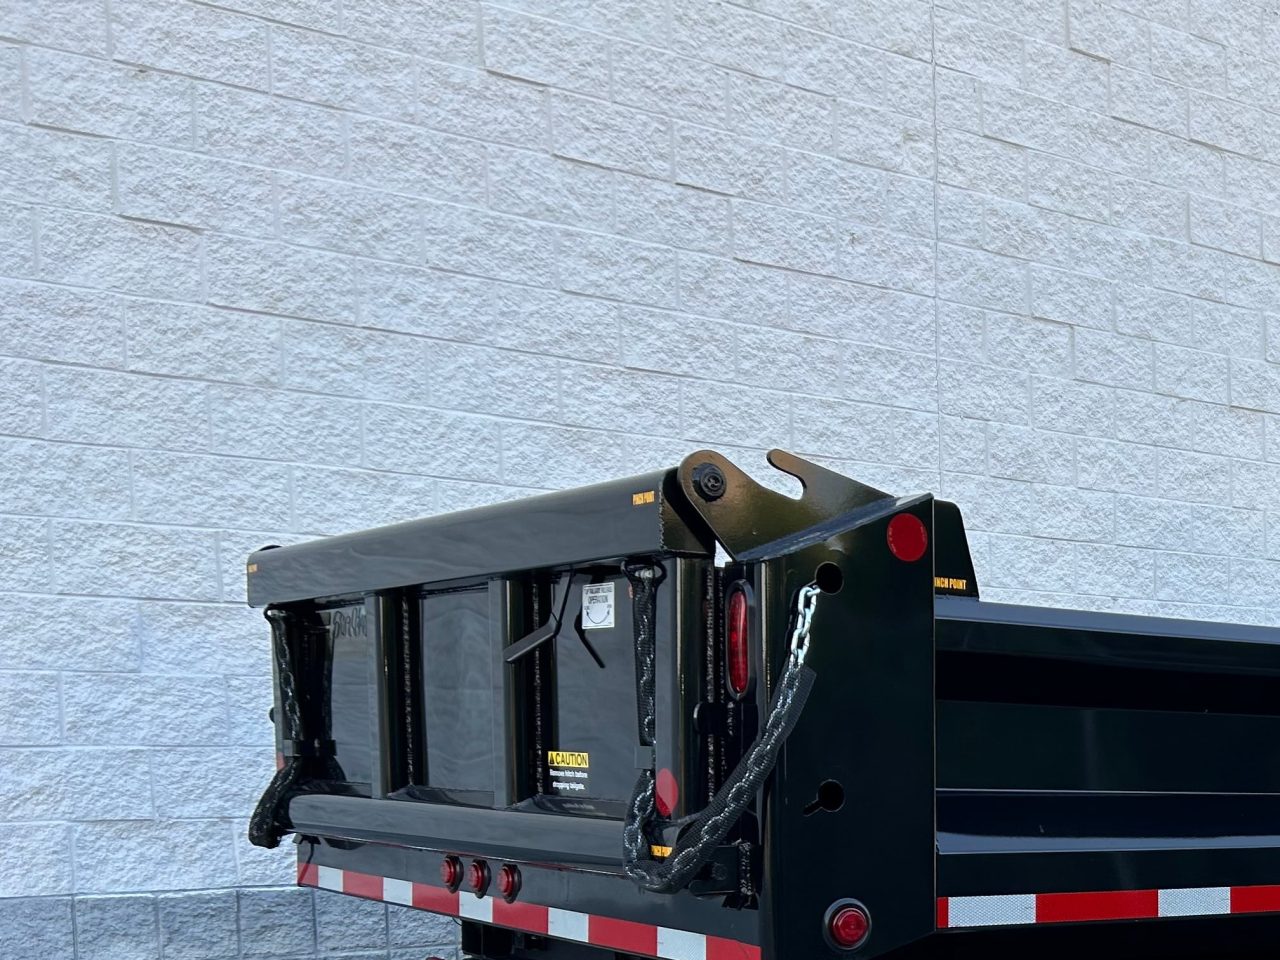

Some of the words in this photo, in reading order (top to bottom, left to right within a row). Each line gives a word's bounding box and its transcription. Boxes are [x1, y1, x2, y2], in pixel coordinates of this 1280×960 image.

[934, 576, 949, 588] INCH
[949, 577, 967, 590] POINT
[555, 752, 588, 766] CAUTION
